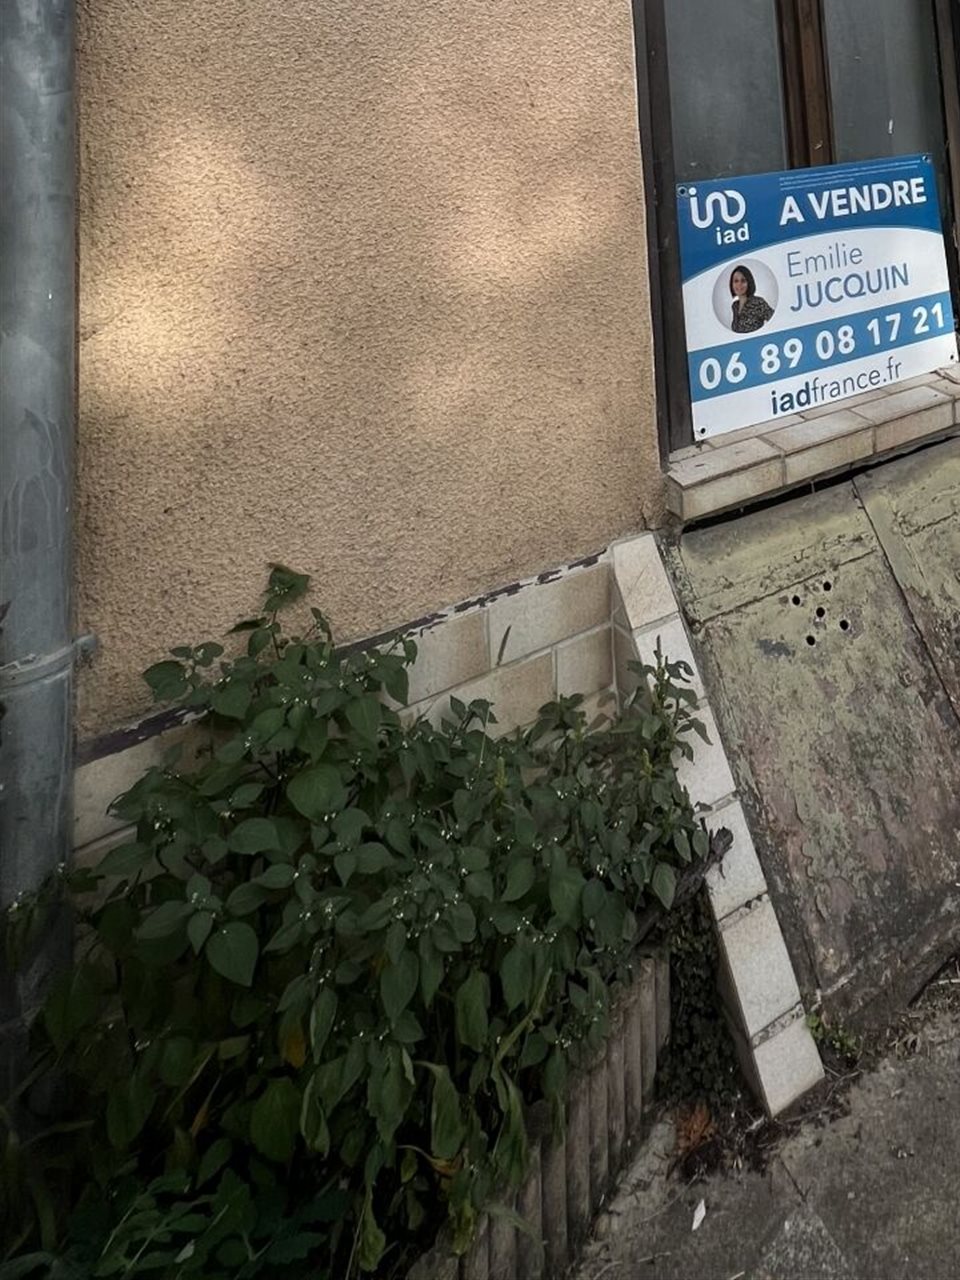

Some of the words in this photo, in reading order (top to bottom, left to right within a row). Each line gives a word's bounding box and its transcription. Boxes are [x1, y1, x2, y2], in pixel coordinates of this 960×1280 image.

[779, 196, 805, 225] A
[807, 177, 927, 219] VENDRE
[716, 222, 750, 245] iad
[787, 242, 863, 277] Emilie
[790, 263, 909, 312] JUCQUIN
[699, 351, 747, 390] 06
[760, 337, 803, 375] 89
[816, 325, 855, 360] 08
[867, 313, 901, 346] 17
[912, 302, 944, 335] 21
[771, 356, 902, 414] iadfrance.fr
